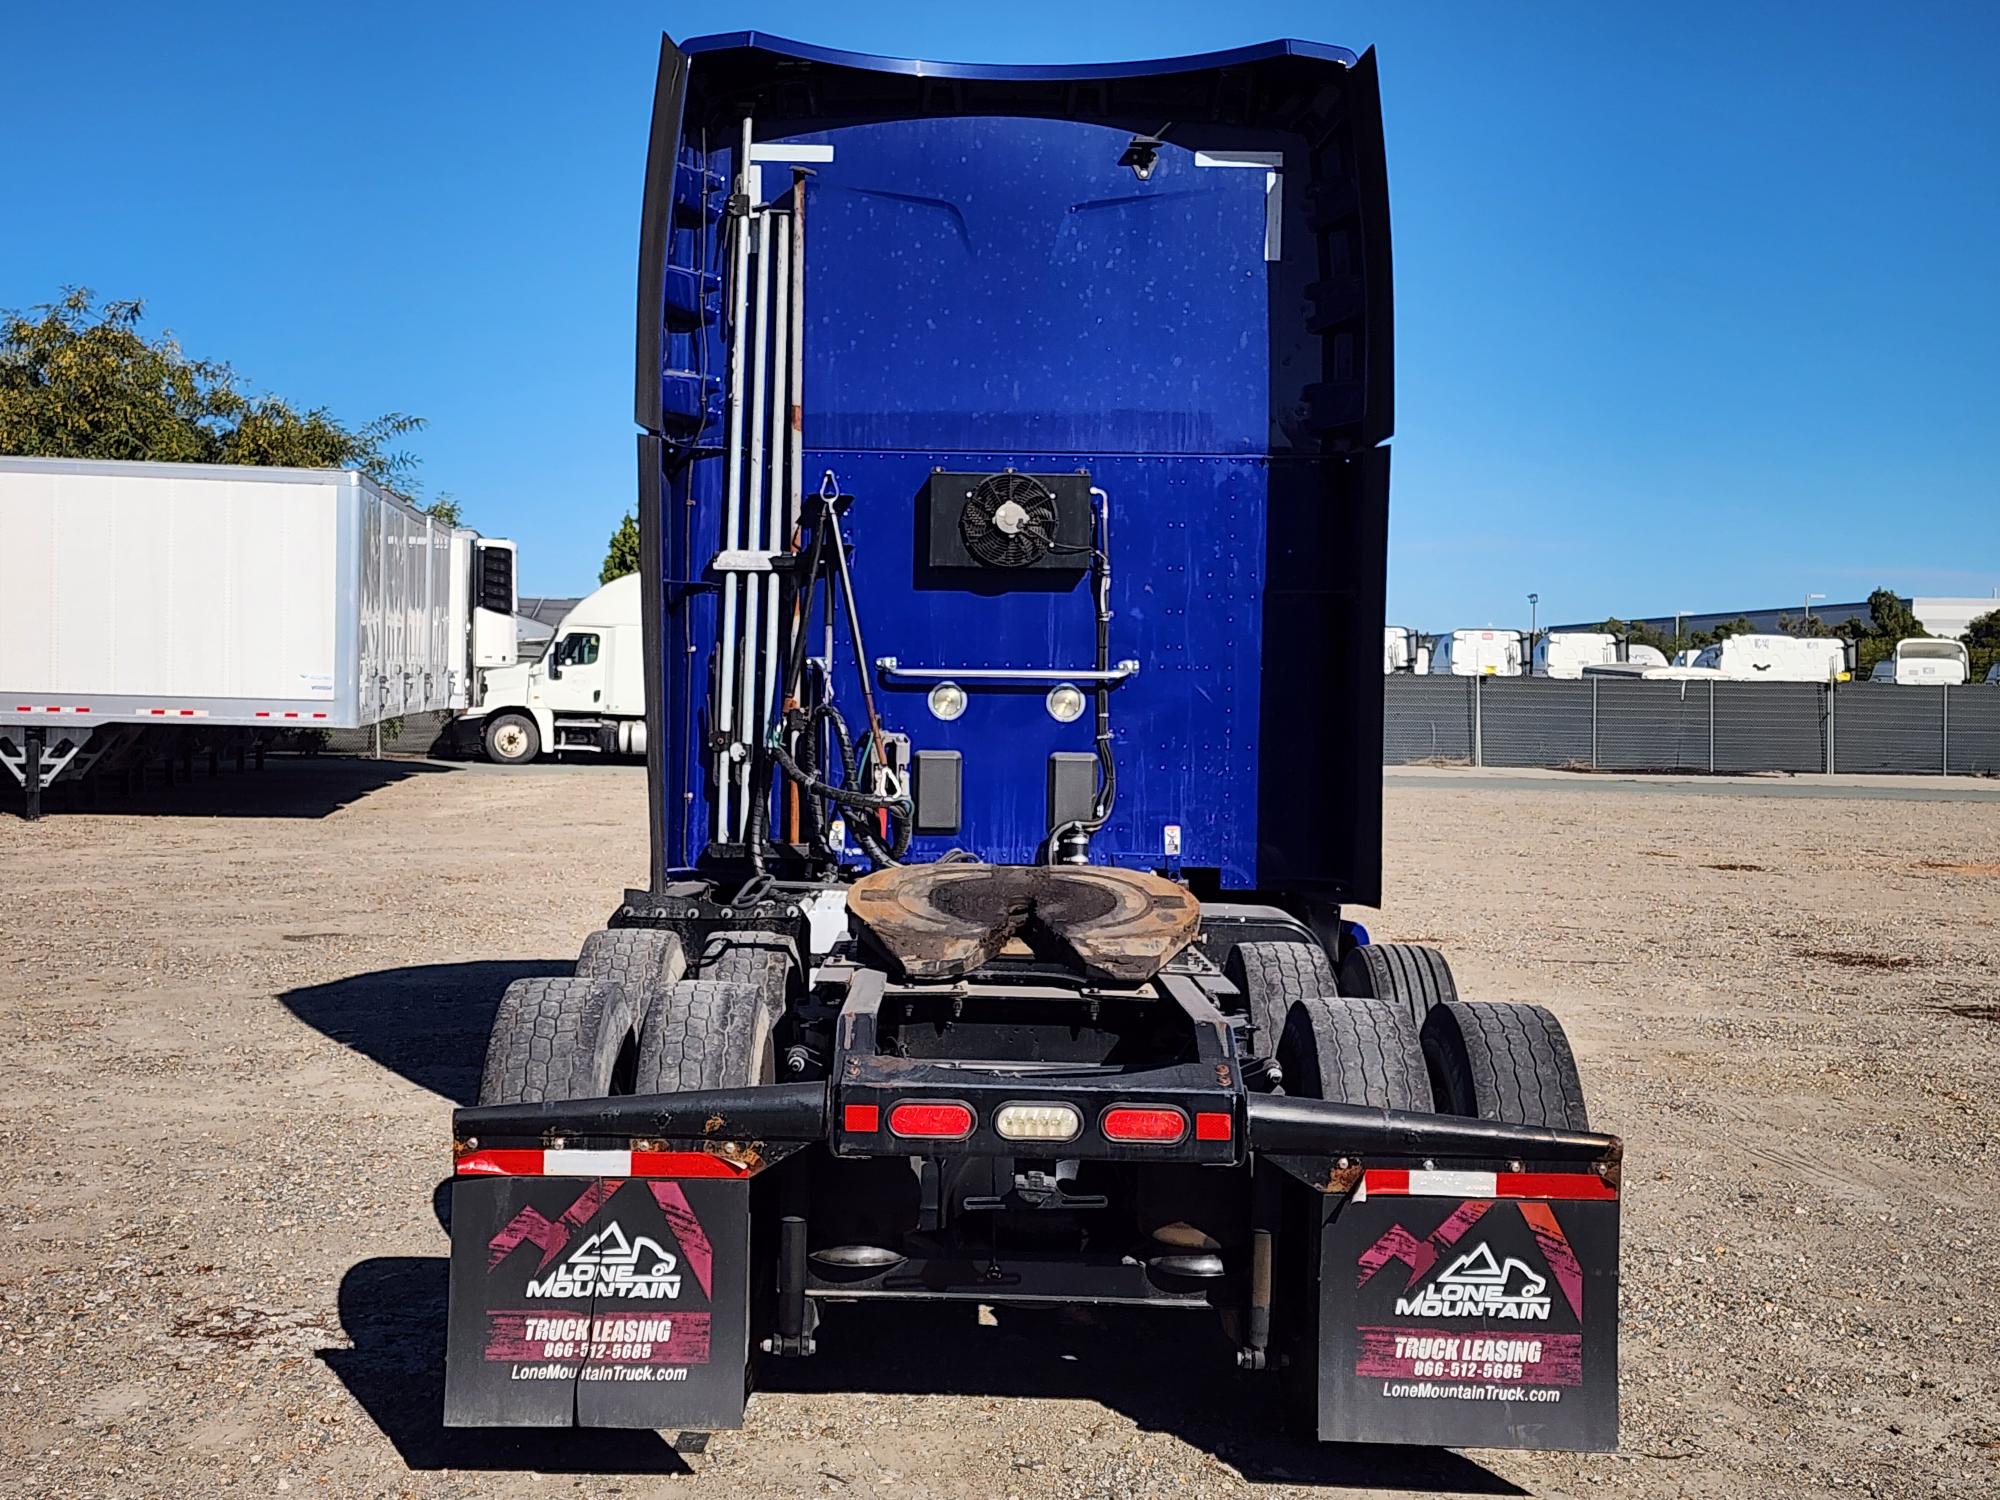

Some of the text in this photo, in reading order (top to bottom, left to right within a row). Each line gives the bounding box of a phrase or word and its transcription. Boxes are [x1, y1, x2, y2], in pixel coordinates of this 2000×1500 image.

[556, 1263, 634, 1283] LONE
[526, 1271, 681, 1298] MOUNTAIN
[1425, 1284, 1505, 1303] LONE
[1395, 1289, 1551, 1320] MOUNTAIN
[525, 1318, 672, 1343] TRUCK LEASING
[1394, 1336, 1543, 1363] TRUCK LEASING
[1413, 1360, 1524, 1379] 866-512-5685
[1383, 1382, 1560, 1402] LoneMountainTruck.com
